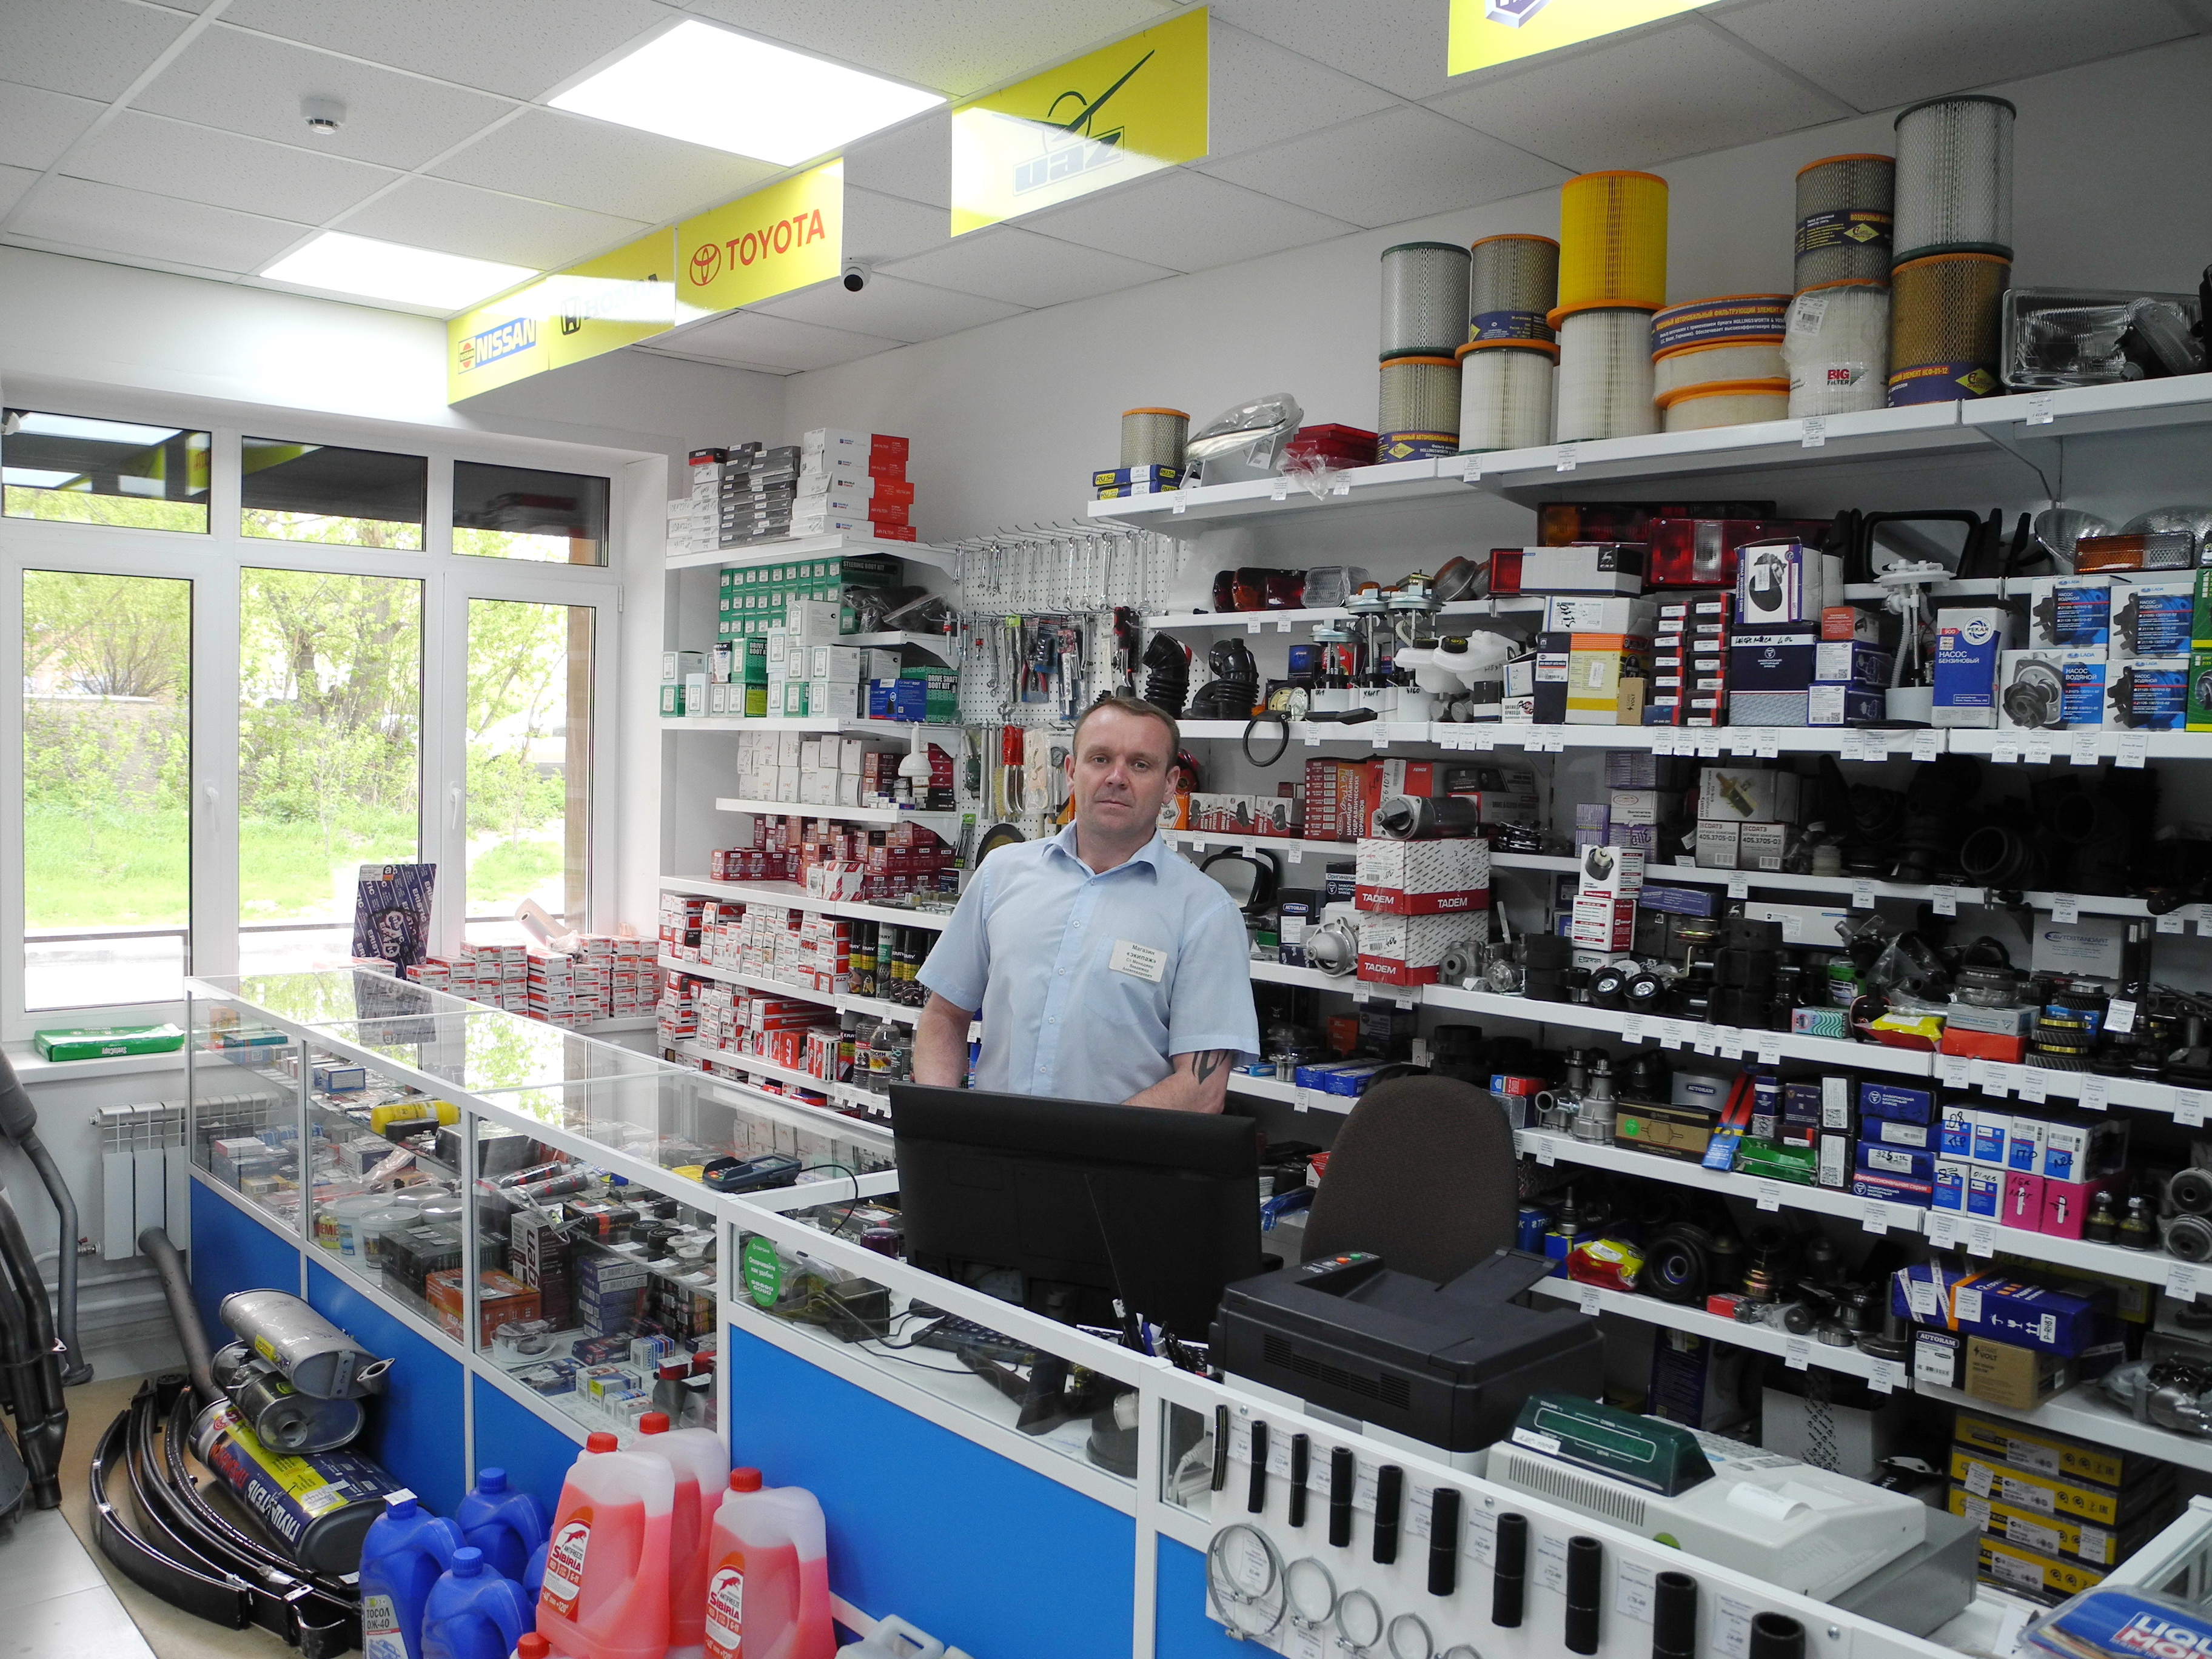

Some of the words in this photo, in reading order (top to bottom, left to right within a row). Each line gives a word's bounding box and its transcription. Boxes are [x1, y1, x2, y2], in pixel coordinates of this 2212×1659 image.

[726, 209, 825, 271] TOYOTA
[1714, 306, 1756, 317] ФИЛЬТРУЮЩИЙ
[475, 319, 536, 364] NISSAN
[1828, 369, 1849, 380] BIG
[843, 560, 864, 569] STEERING
[928, 674, 943, 683] DRIVE
[943, 675, 958, 684] SHAFT
[1698, 834, 1737, 842] 405.3705-03
[1742, 837, 1781, 845] 405.3705-03
[1362, 893, 1395, 905] TADEM
[1437, 896, 1468, 908] TADEM
[412, 888, 427, 923] ERISTIC
[2053, 933, 2109, 943] AVTOSTANDART
[1131, 945, 1155, 956] Магазин
[1364, 962, 1397, 975] TADEM
[1855, 1173, 1909, 1188] Профессиональная
[1909, 1184, 1928, 1192] серия
[748, 1256, 776, 1272] Оплачивайте
[759, 1269, 774, 1280] удобно
[1919, 1333, 1956, 1347] AUTORAM
[1979, 1352, 1998, 1361] VOLT
[564, 1546, 583, 1561] ANTIFREEZE
[720, 1592, 740, 1608] ANTIFREEZE
[366, 1607, 390, 1619] ТОСОЛ
[367, 1618, 390, 1630] ОЖ-40
